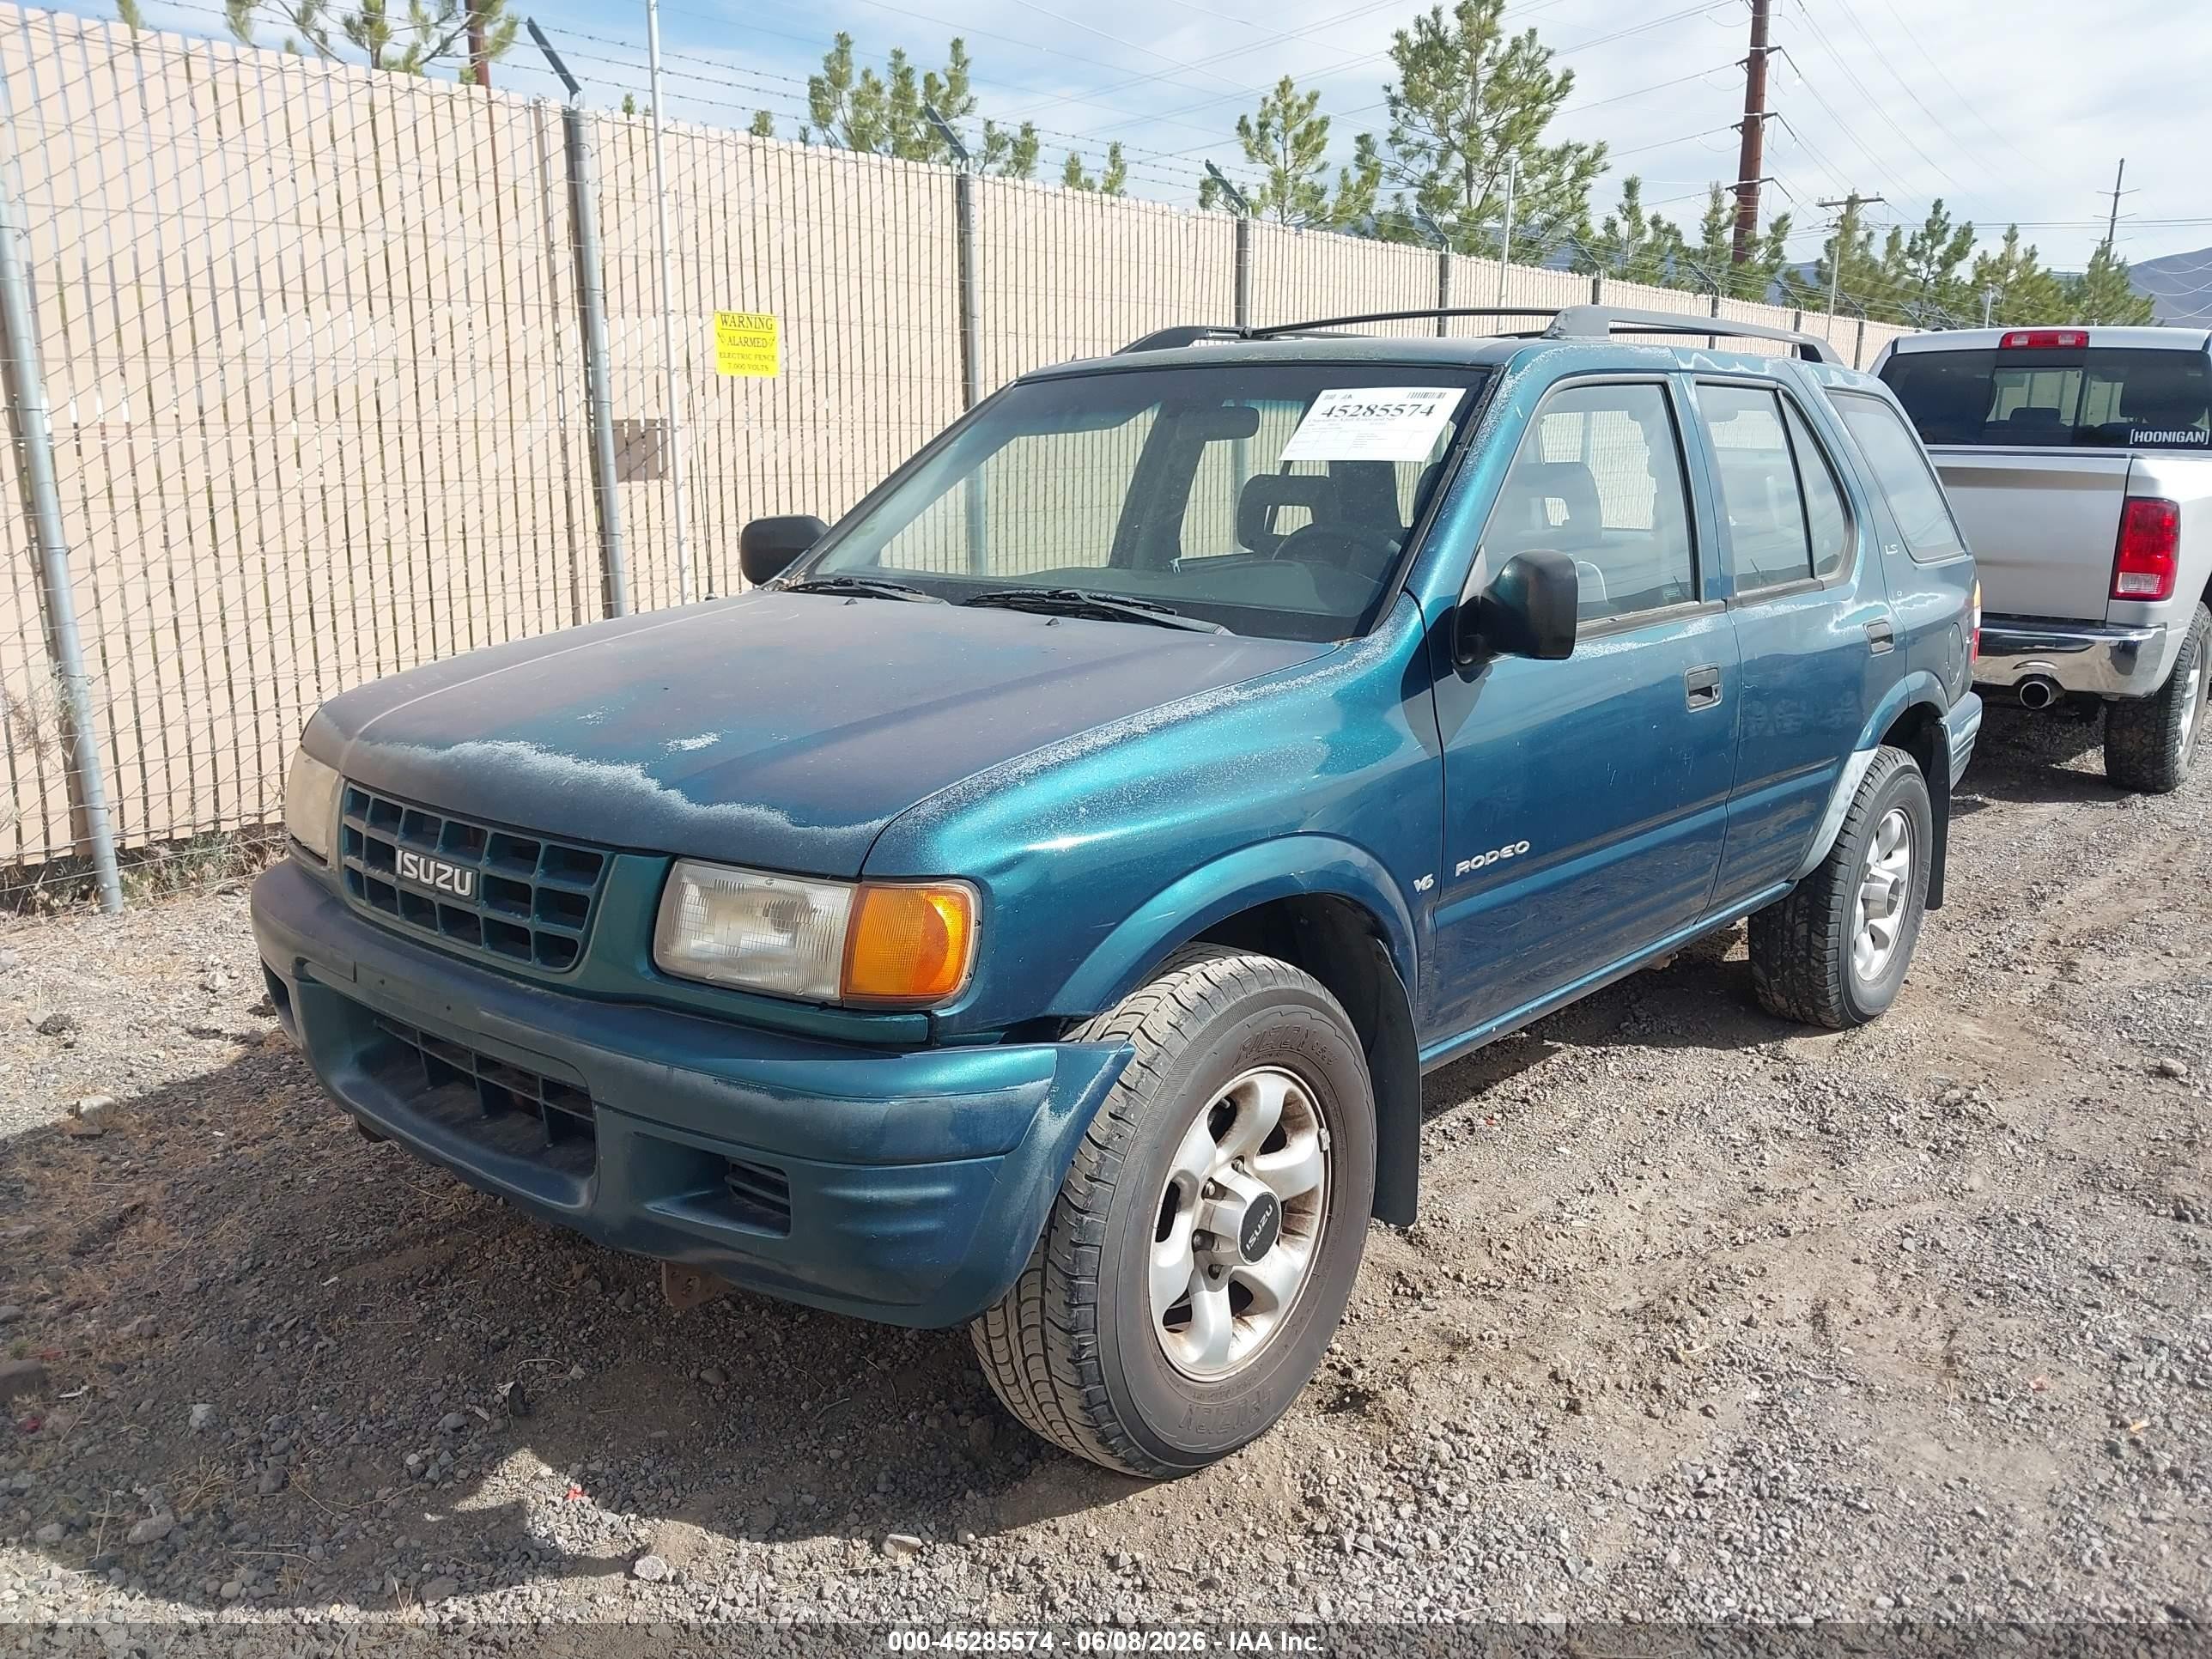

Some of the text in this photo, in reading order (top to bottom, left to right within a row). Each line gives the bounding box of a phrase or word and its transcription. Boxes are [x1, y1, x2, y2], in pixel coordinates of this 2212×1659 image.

[720, 314, 773, 331] WARNING
[727, 336, 768, 348] ALARMED
[720, 351, 752, 360] ELECTRIC
[1321, 404, 1436, 417] 45285574
[1885, 544, 1898, 555] LS
[1455, 840, 1530, 878] RODEO
[397, 849, 473, 896] ISUZU
[1413, 873, 1434, 893] V6
[1245, 1204, 1273, 1251] ISUZU
